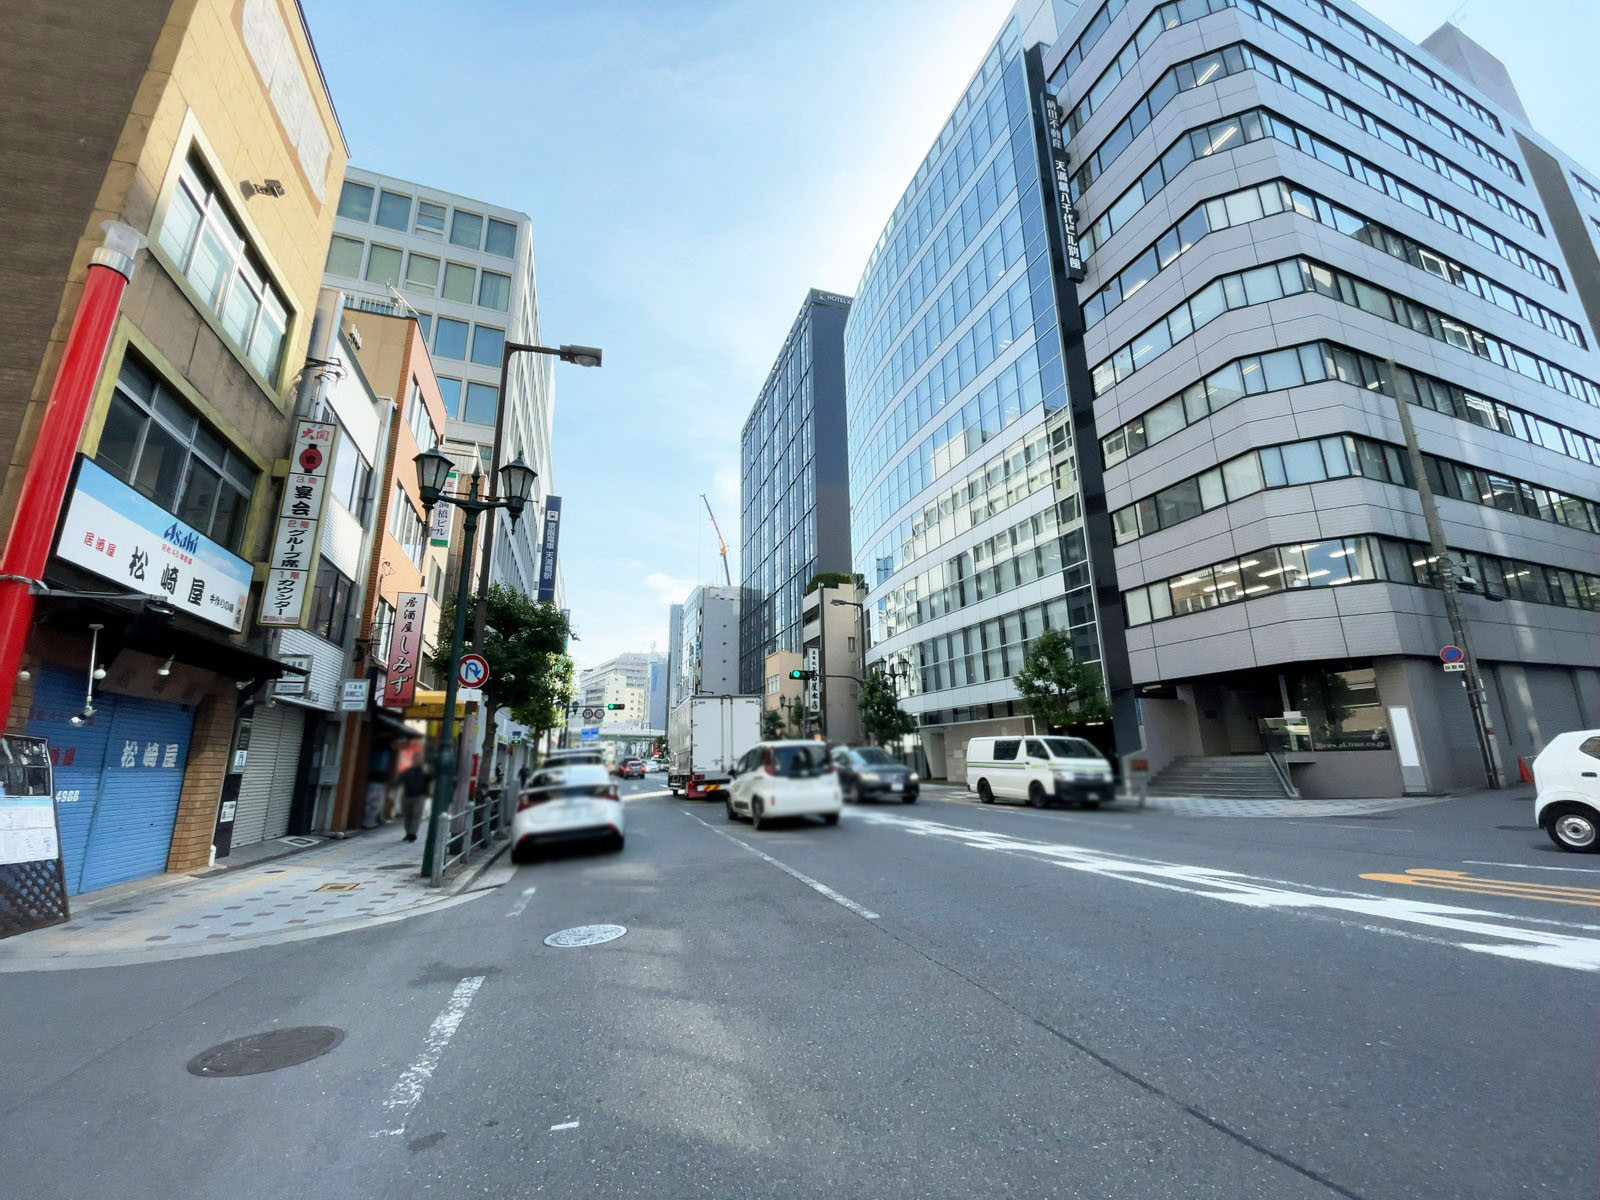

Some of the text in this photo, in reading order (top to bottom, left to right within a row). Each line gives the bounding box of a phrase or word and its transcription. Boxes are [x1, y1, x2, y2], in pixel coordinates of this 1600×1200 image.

[292, 486, 313, 516] 宴会
[83, 531, 117, 558] 居酒屋
[163, 522, 200, 554] Asahi
[281, 529, 308, 568] グループ席
[274, 579, 296, 616] カウンター
[389, 597, 418, 696] 居酒屋 しみず
